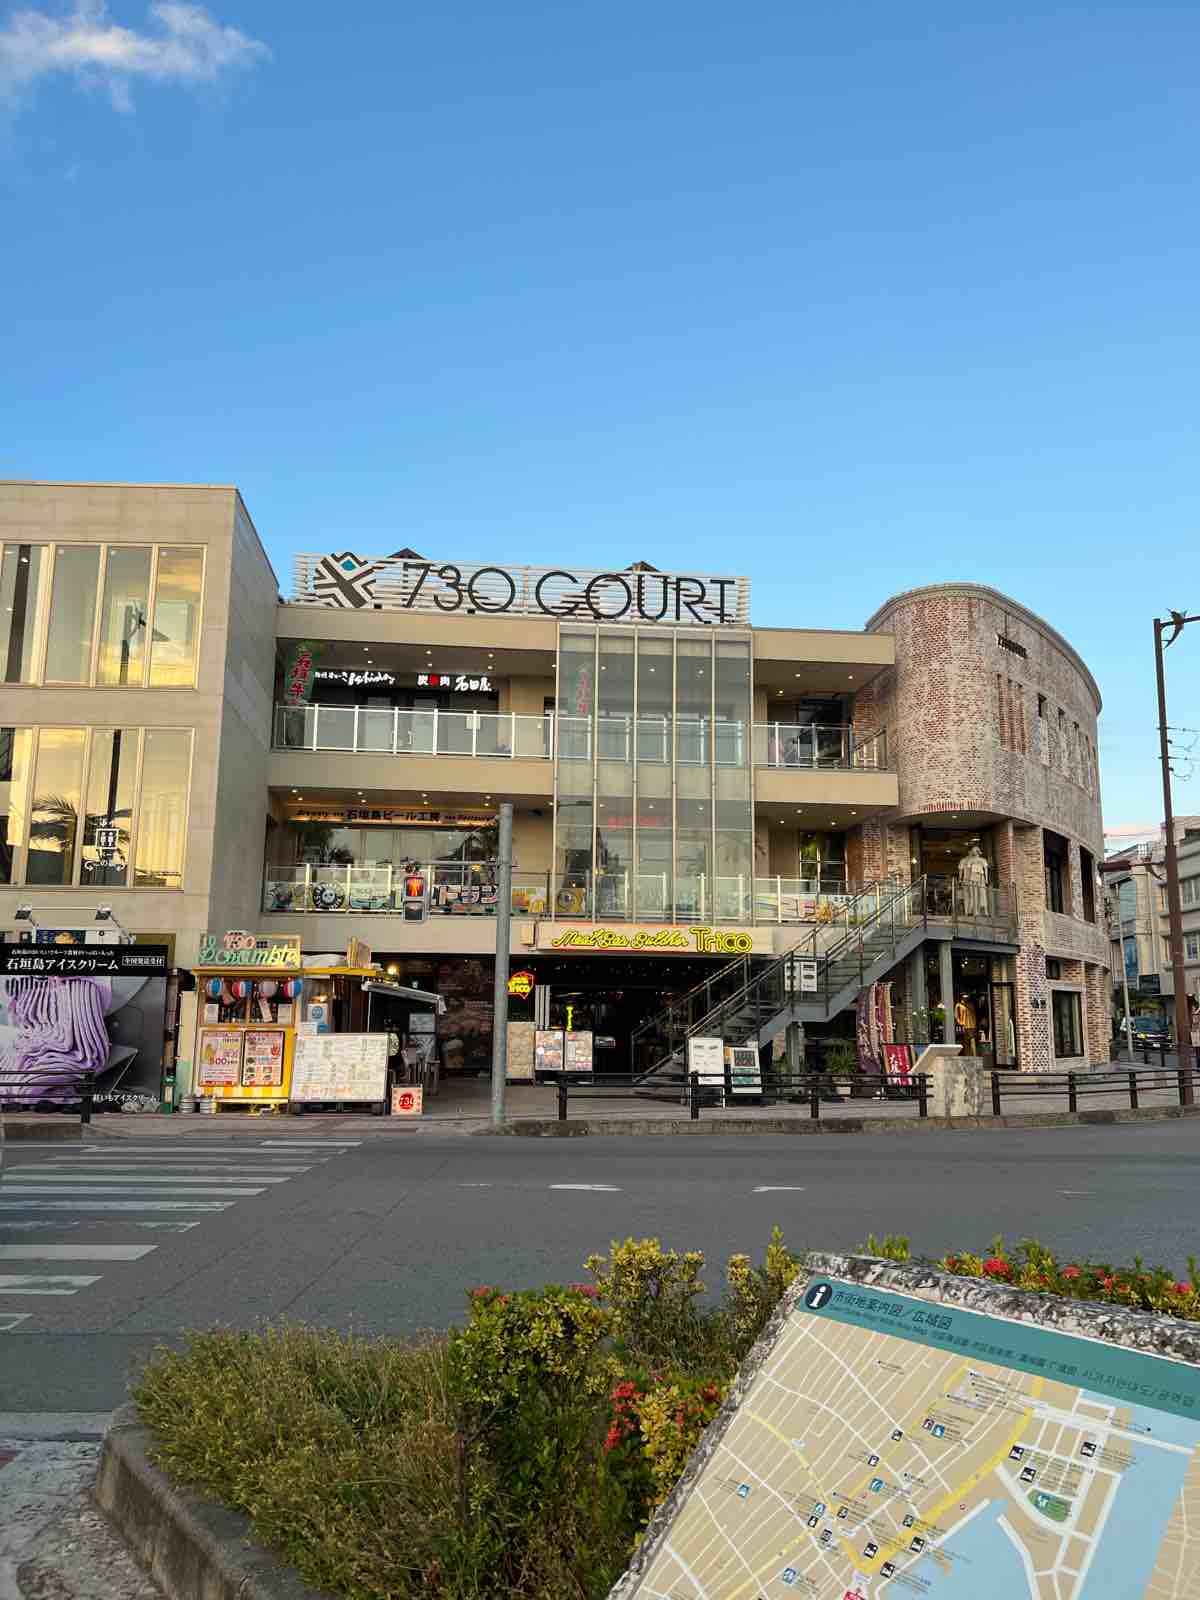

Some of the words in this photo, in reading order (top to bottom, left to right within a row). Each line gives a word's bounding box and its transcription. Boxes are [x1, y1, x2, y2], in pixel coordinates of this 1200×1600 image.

[402, 562, 517, 613] 730
[535, 570, 737, 625] COURT
[689, 926, 753, 953] Trico
[6, 957, 119, 971] 石垣島アイスクリーム
